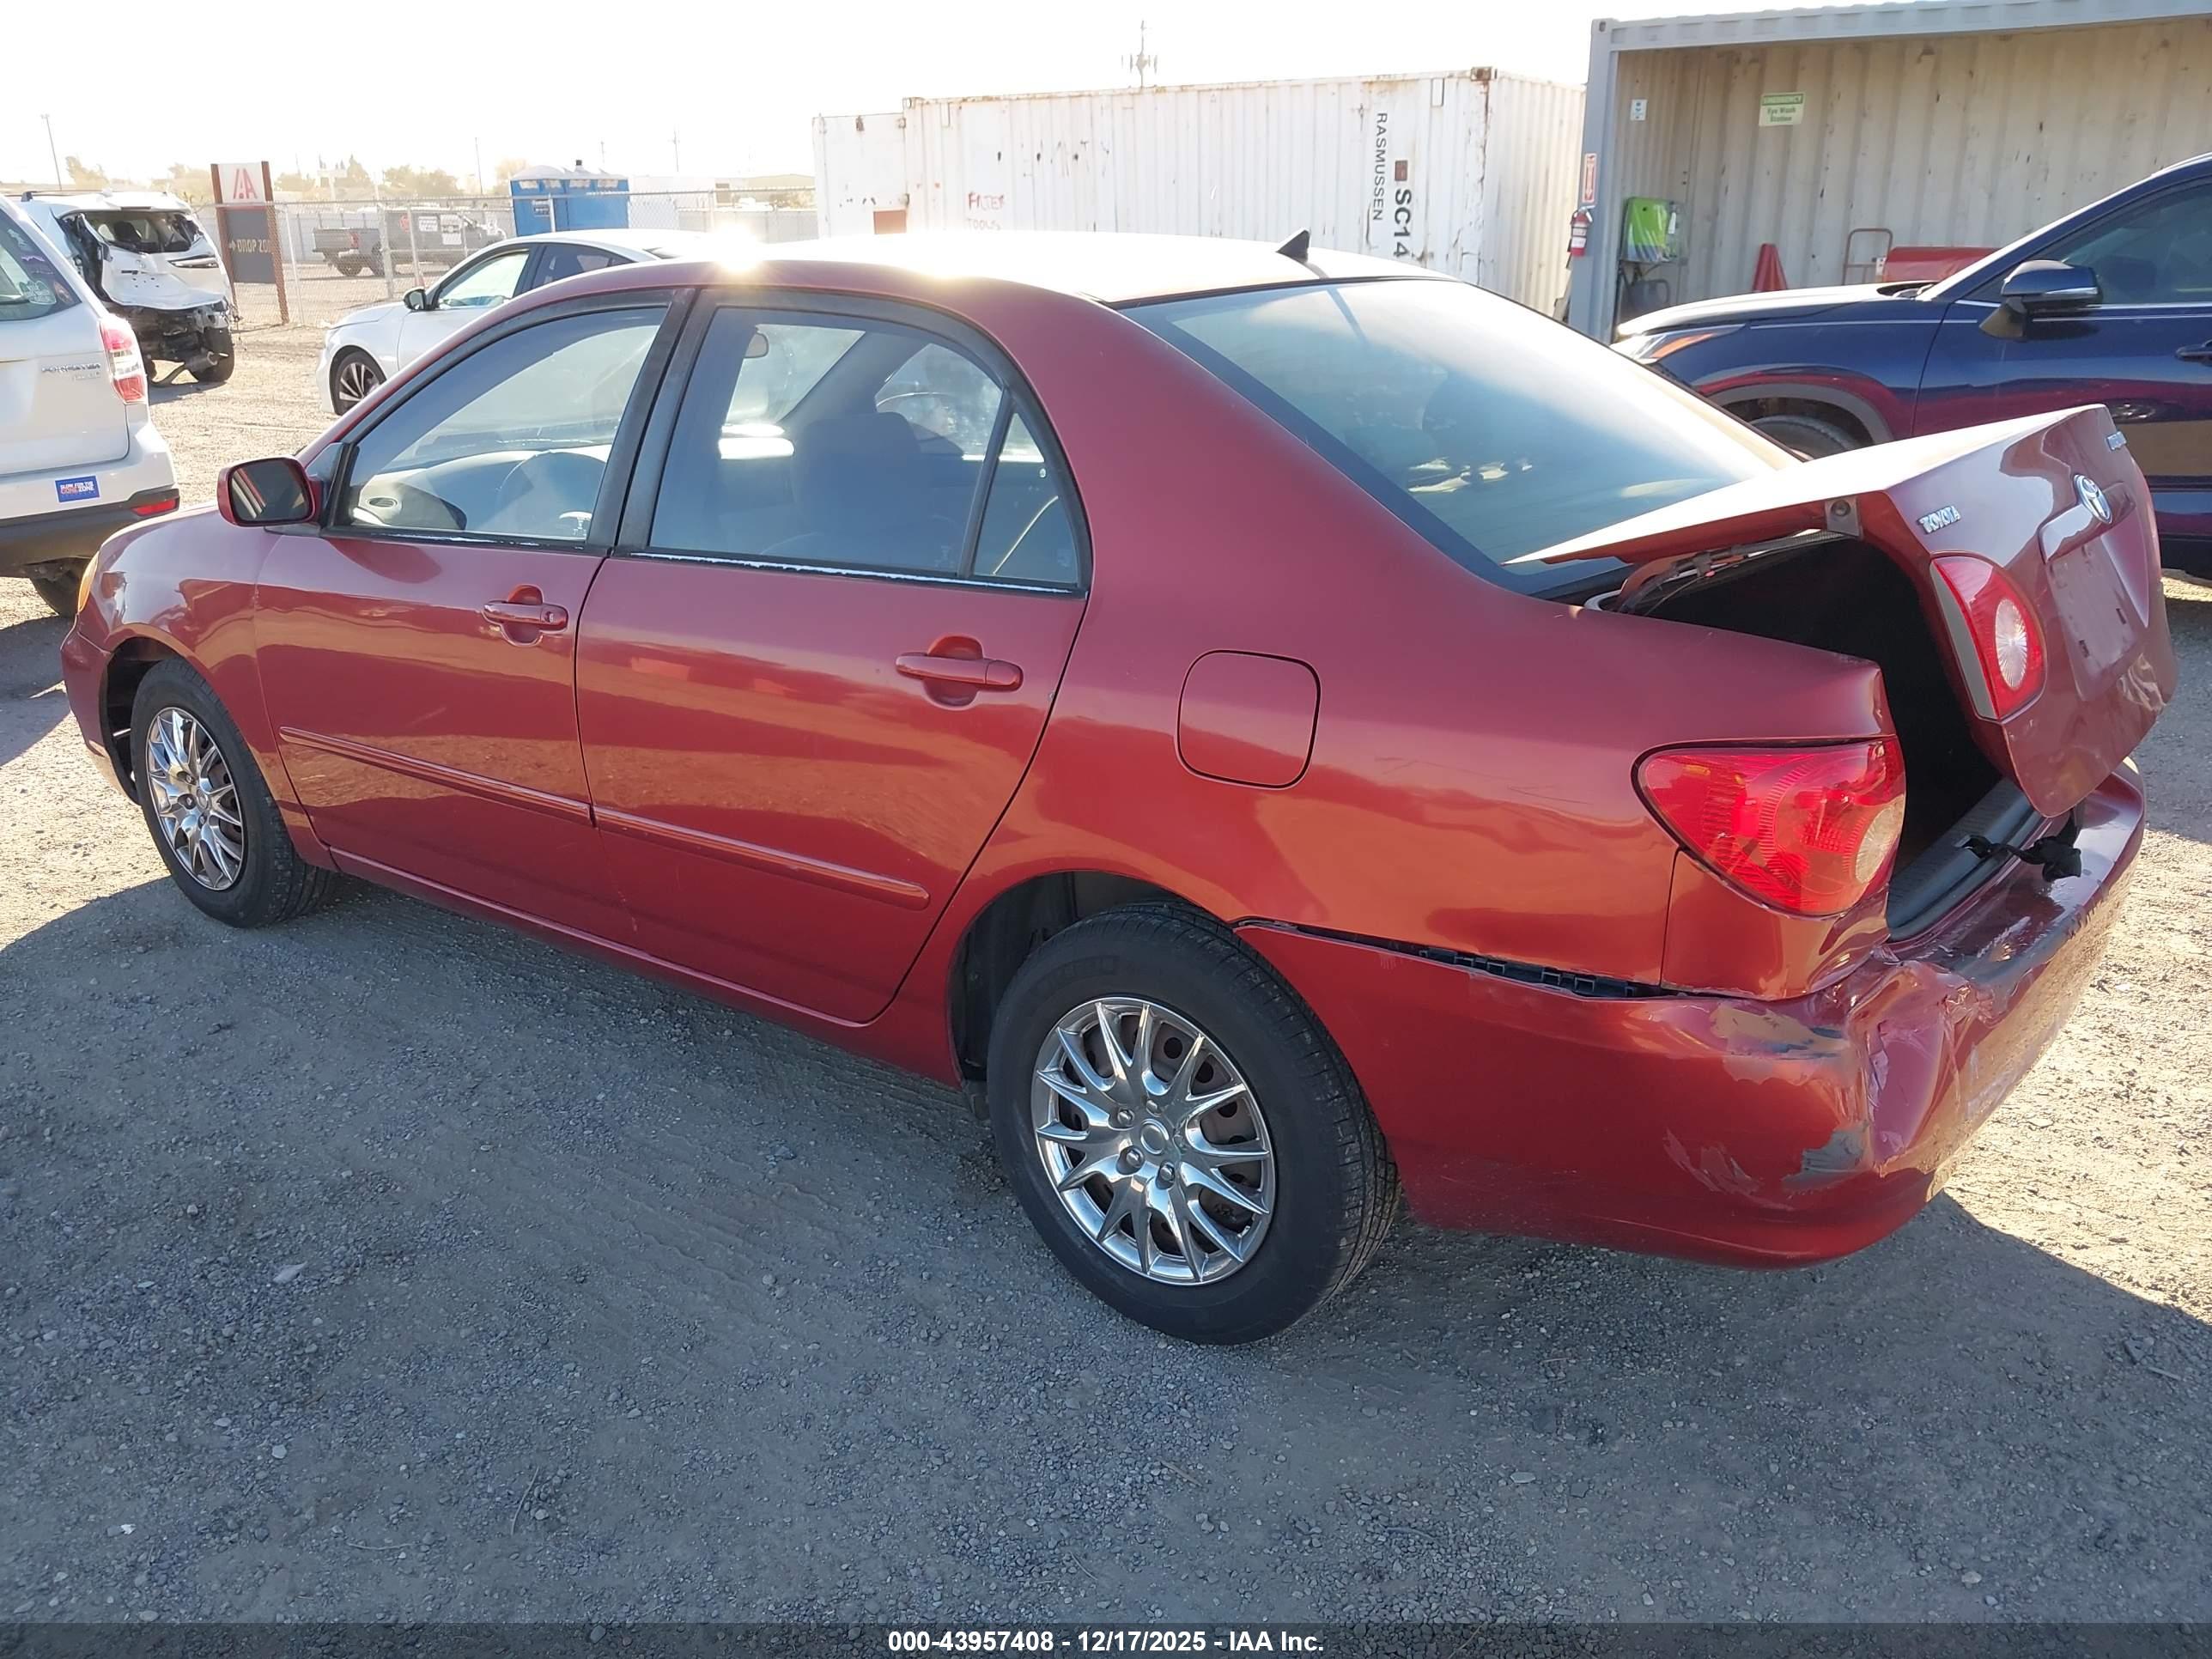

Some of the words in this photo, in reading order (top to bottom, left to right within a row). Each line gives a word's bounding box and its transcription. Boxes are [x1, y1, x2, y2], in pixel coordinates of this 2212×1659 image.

[1373, 112, 1388, 220] RASMUSSEN
[237, 240, 257, 252] DROP
[1393, 188, 1412, 257] SC14
[1917, 505, 1961, 533] TOYOTA
